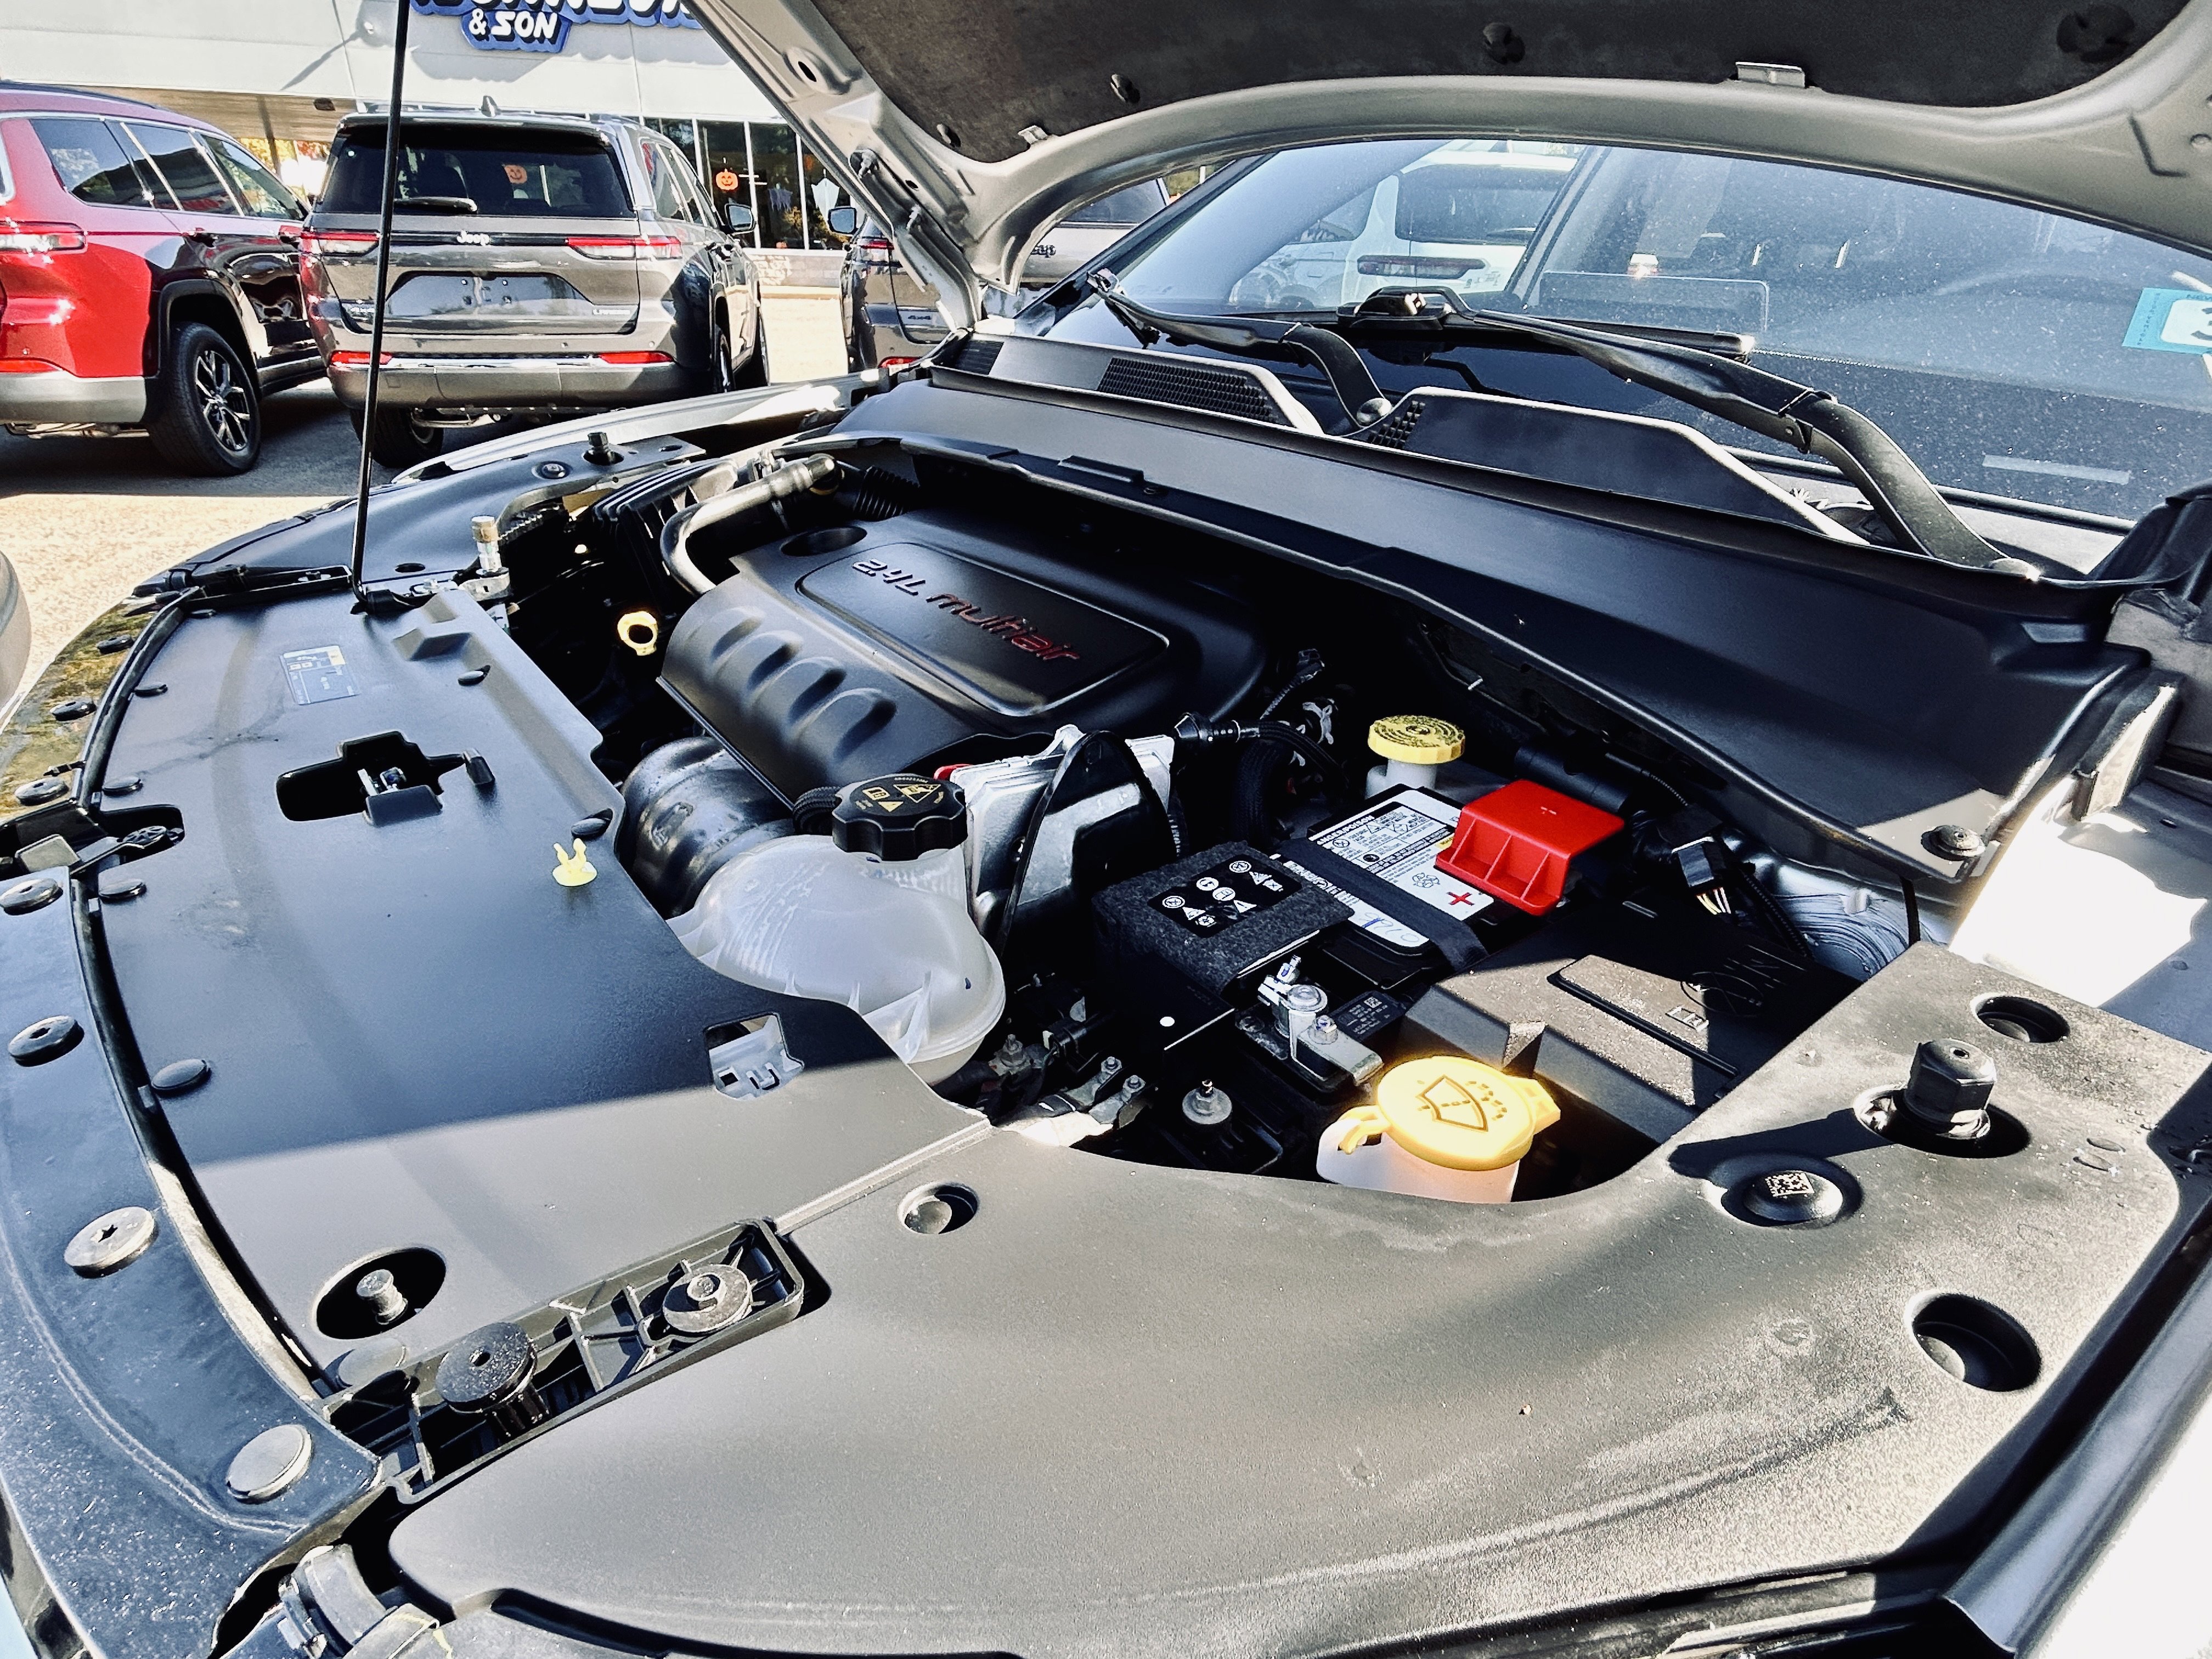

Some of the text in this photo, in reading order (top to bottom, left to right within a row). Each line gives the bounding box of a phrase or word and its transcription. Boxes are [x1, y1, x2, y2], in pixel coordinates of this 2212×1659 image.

[469, 8, 487, 35] &
[490, 10, 558, 39] SON
[456, 230, 490, 246] Jeep
[1031, 245, 1056, 258] eep
[1317, 815, 1375, 845] ANGER/POISON
